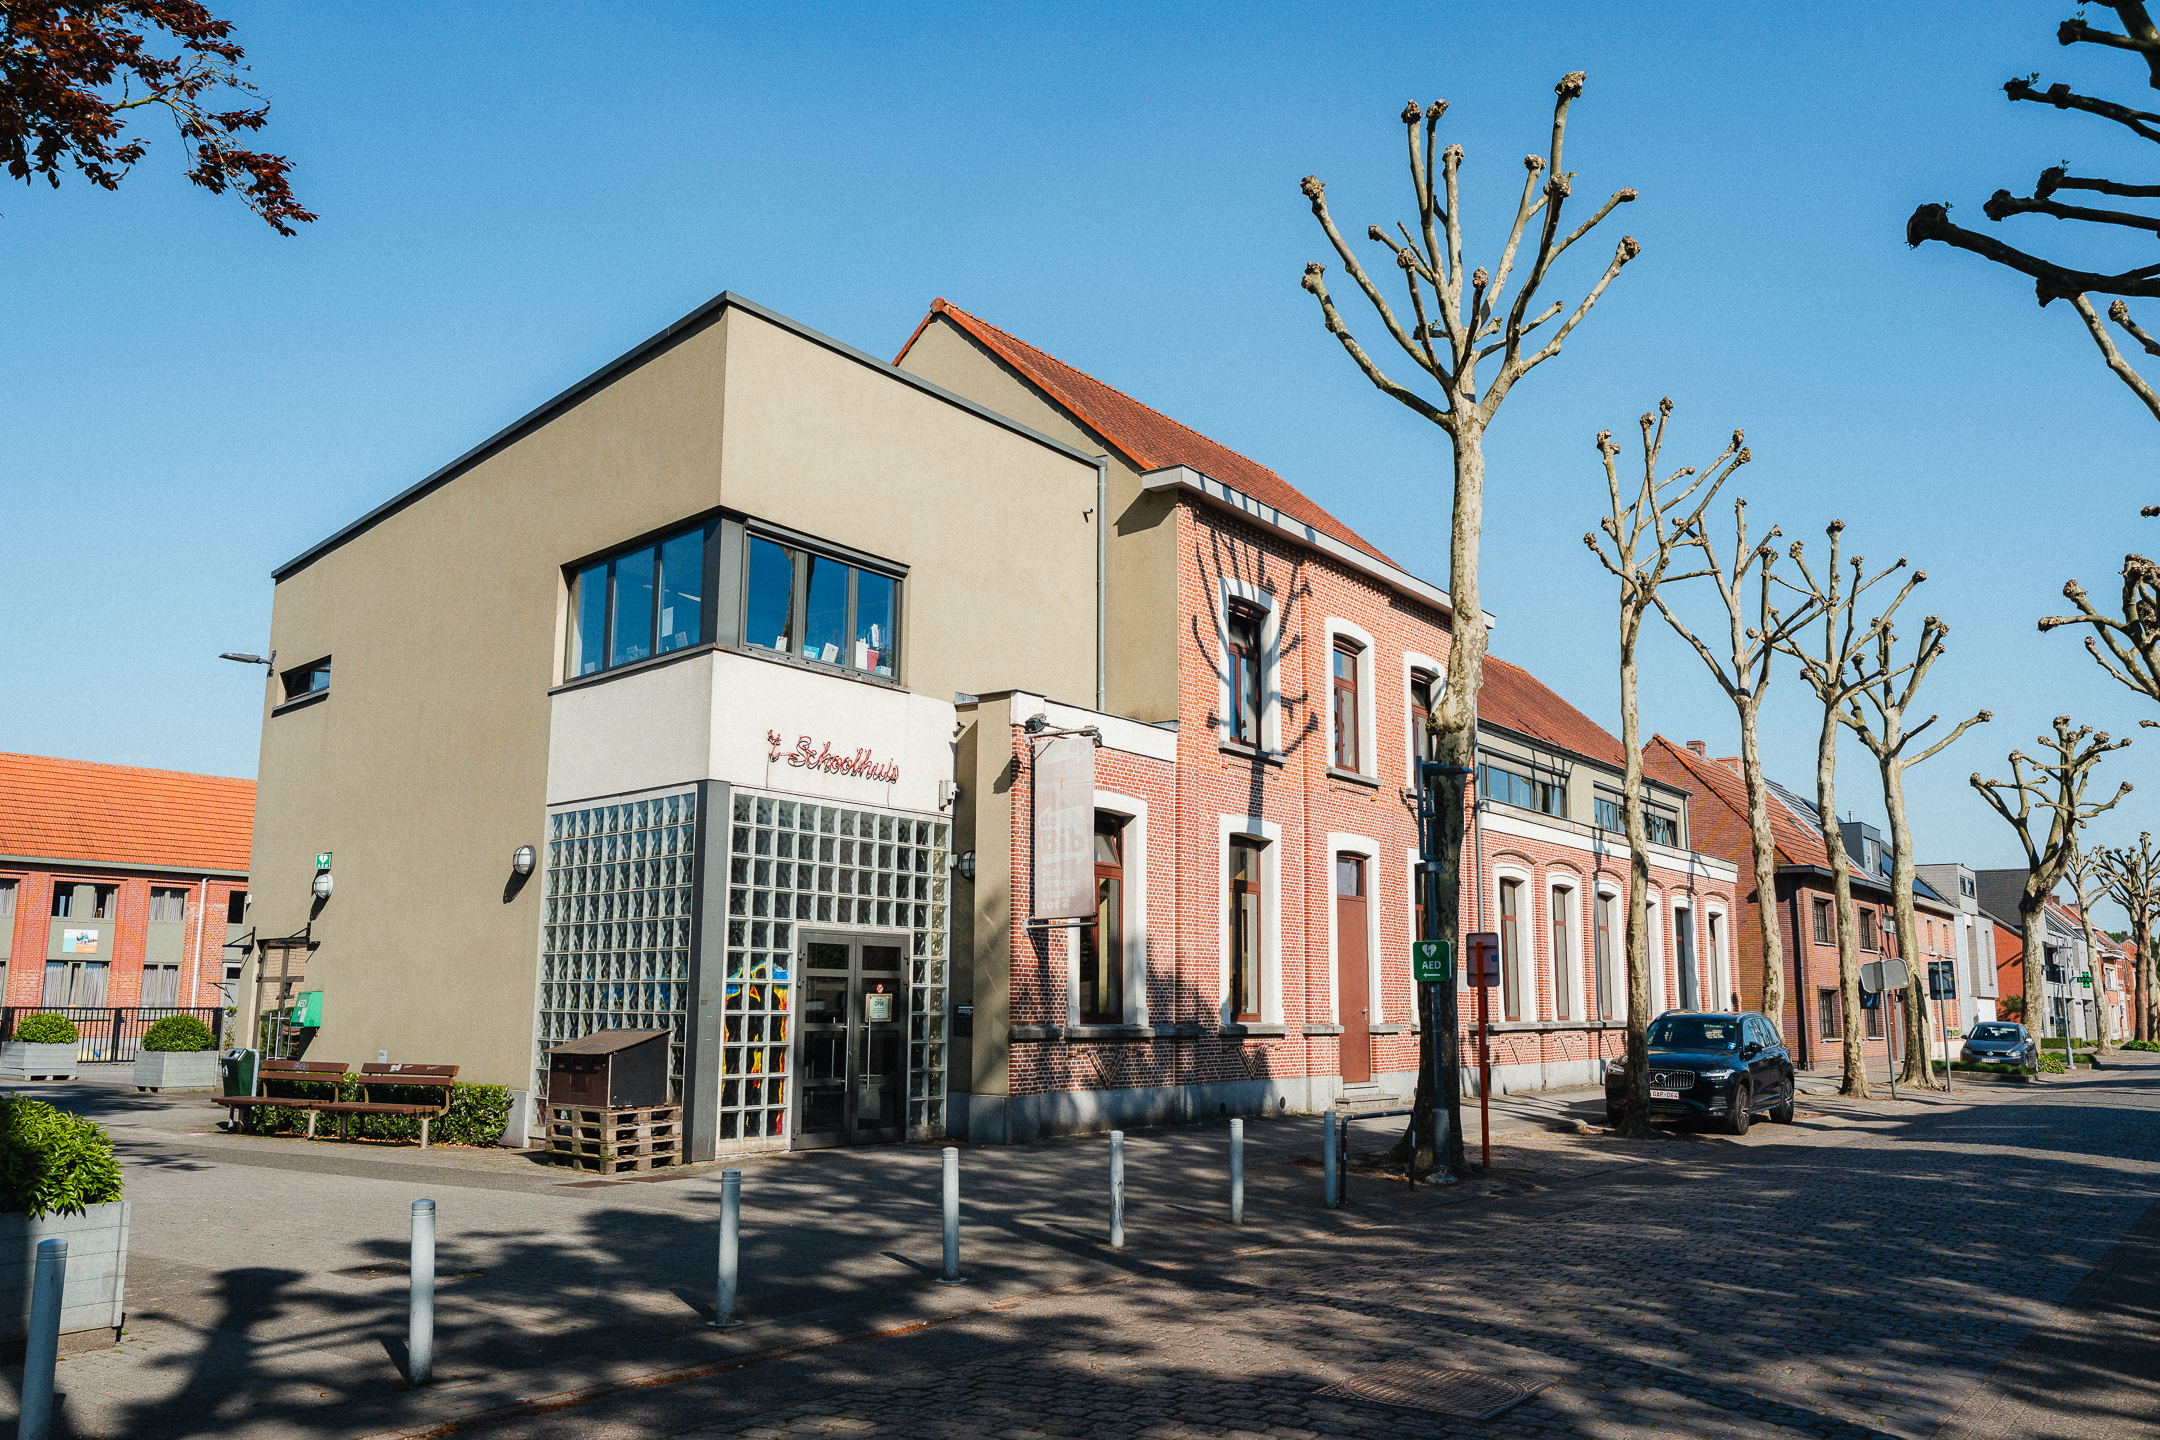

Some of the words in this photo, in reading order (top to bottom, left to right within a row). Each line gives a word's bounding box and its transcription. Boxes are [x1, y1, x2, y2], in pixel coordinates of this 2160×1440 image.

[767, 729, 782, 759] 't
[788, 736, 900, 782] Schoolhuis
[1040, 813, 1057, 828] de
[1039, 828, 1085, 855] Bib
[1041, 866, 1063, 877] het
[1041, 877, 1076, 888] leven
[1041, 890, 1065, 898] van
[1067, 887, 1076, 897] A
[1041, 899, 1060, 910] tot
[1061, 898, 1070, 909] Z
[1421, 960, 1442, 970] AED
[297, 999, 307, 1007] AED
